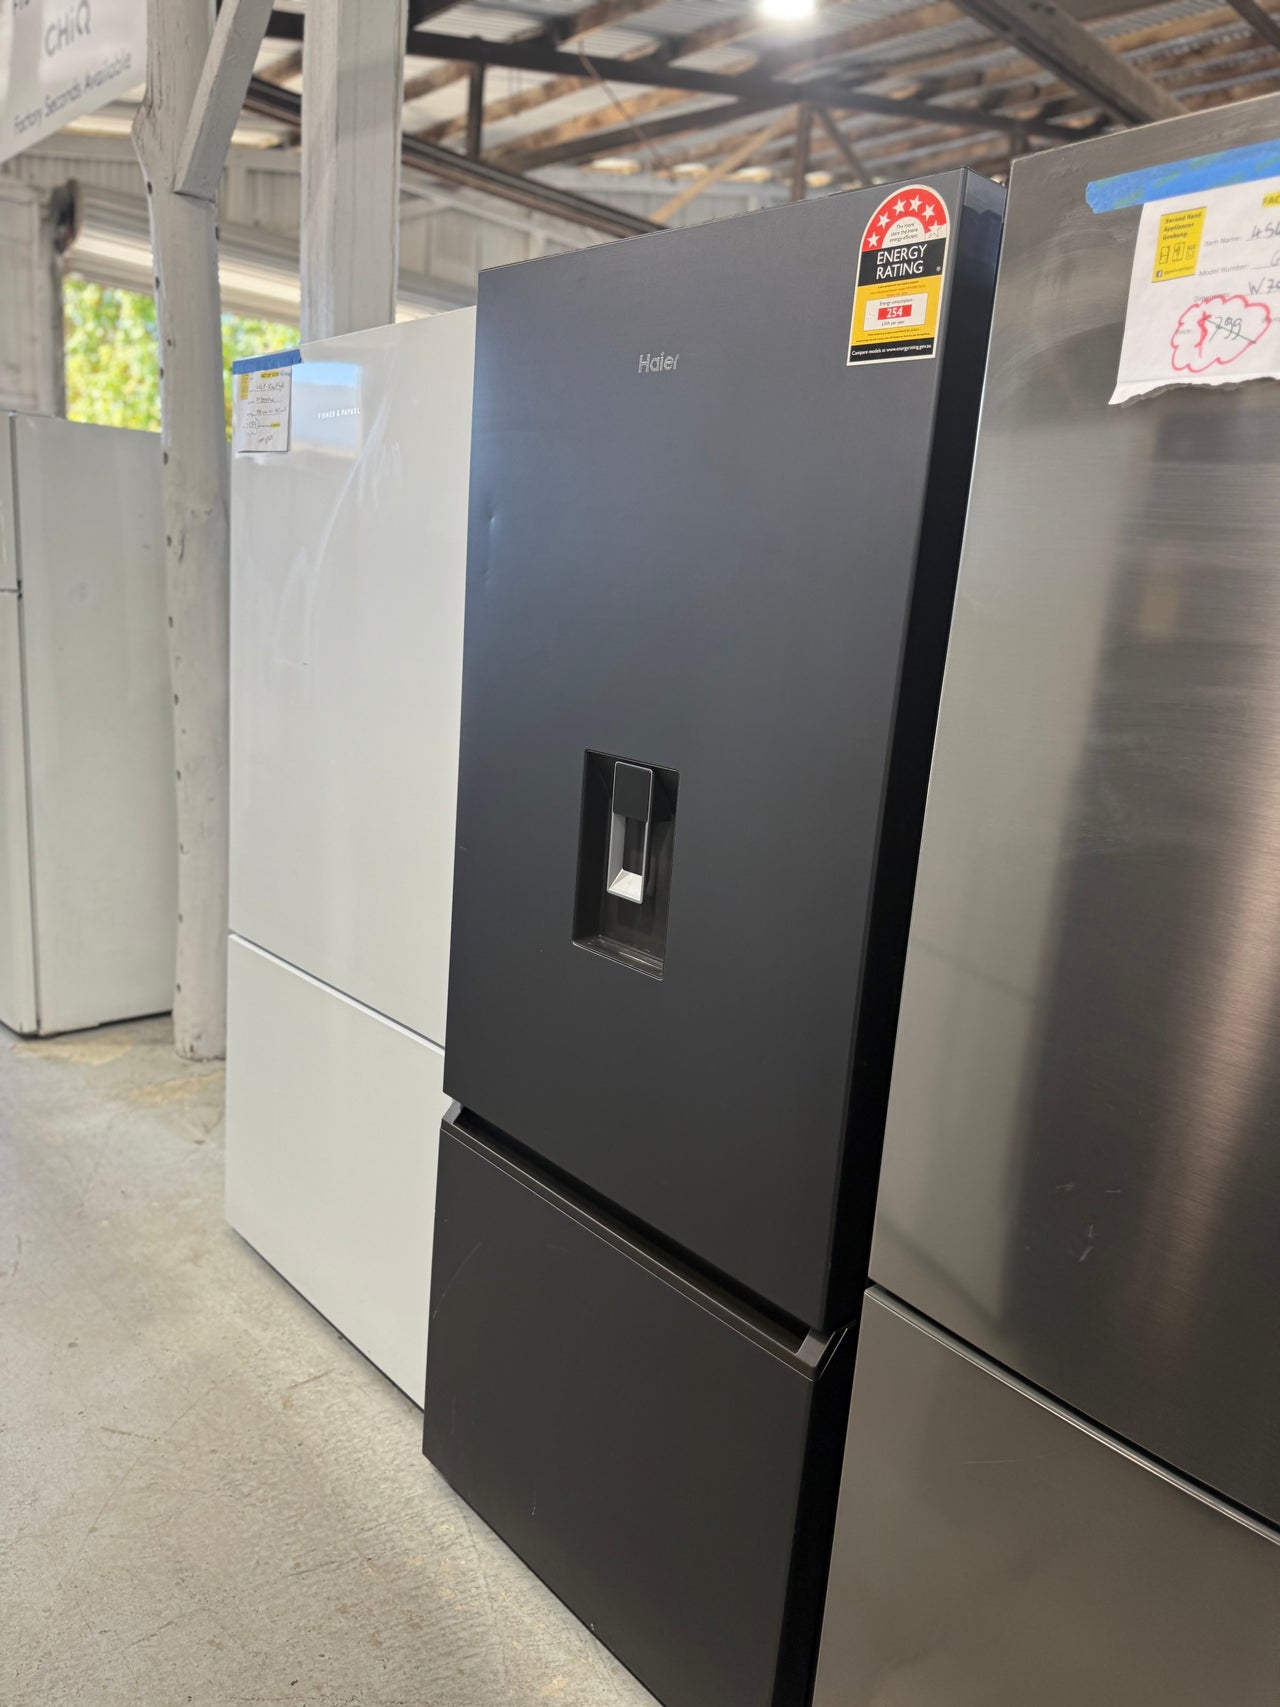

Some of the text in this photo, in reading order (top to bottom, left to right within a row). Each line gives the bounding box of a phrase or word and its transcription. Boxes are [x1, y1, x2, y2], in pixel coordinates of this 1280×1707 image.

[45, 77, 82, 117] Seconds
[85, 50, 132, 90] Available
[1163, 222, 1195, 233] Appliances
[1164, 215, 1186, 224] Second
[877, 244, 927, 264] ENERGY
[876, 261, 923, 279] RATING
[886, 306, 903, 318] 254
[638, 351, 680, 373] Haier
